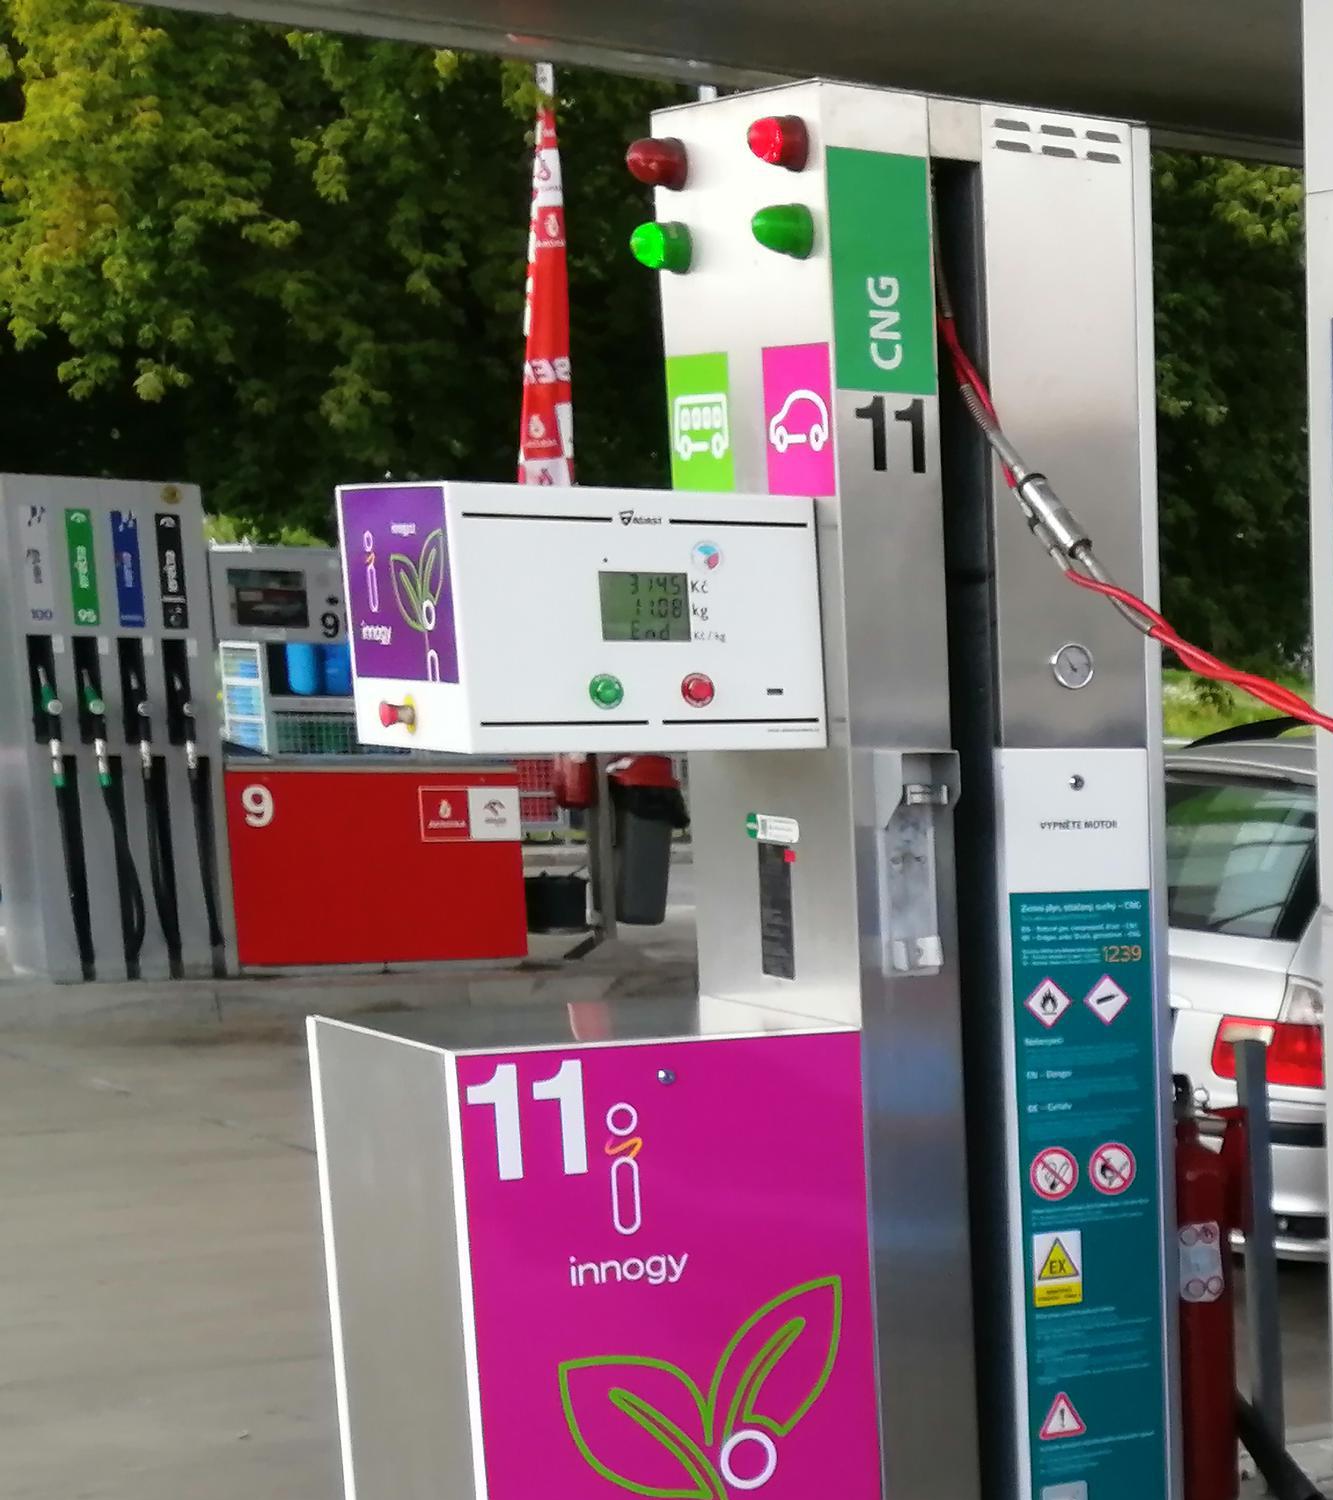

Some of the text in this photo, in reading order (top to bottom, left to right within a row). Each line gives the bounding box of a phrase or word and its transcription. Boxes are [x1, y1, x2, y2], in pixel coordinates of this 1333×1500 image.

[866, 276, 901, 370] CNG
[855, 395, 926, 473] 11
[320, 612, 339, 638] 9
[692, 603, 709, 620] kg
[240, 784, 274, 828] 9
[1084, 819, 1117, 830] MOTOR
[1103, 945, 1142, 963] 1239
[466, 1059, 588, 1180] 11
[569, 1250, 689, 1287] innogy
[1049, 1259, 1066, 1275] EX
